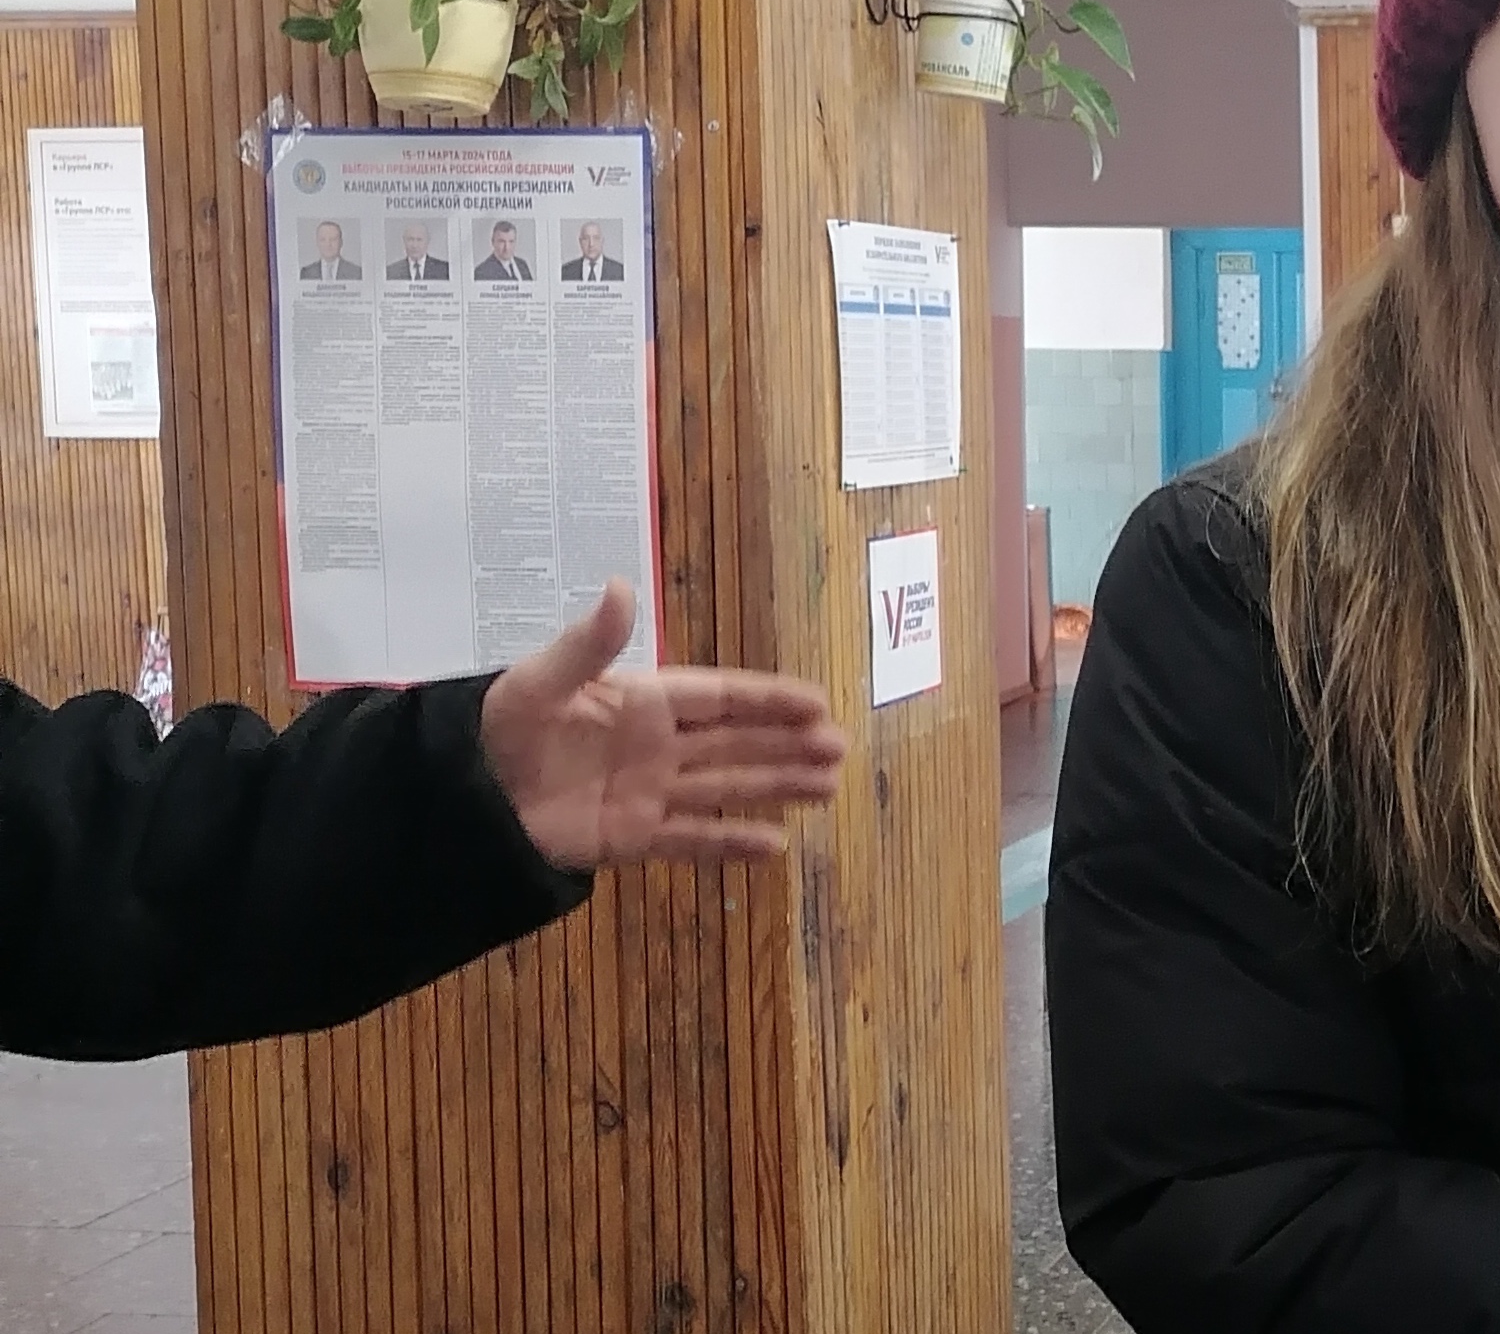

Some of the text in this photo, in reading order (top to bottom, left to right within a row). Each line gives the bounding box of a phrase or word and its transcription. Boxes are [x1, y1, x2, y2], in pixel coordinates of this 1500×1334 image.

[428, 150, 460, 160] МАРТА
[462, 150, 485, 160] 2024
[487, 150, 512, 161] ГОДА
[386, 164, 447, 175] ПРЕЗИДЕНТА
[450, 163, 514, 175] РОССИЙСКОЙ
[516, 164, 574, 175] ФЕДЕРАЦИИ
[344, 181, 574, 194] КАНДИДАТЫ НА ДОЛЖНОСТЬ ПРЕЗИДЕНТА
[386, 195, 533, 210] РОССИЙСКОЙ ФЕДЕРАЦИИ
